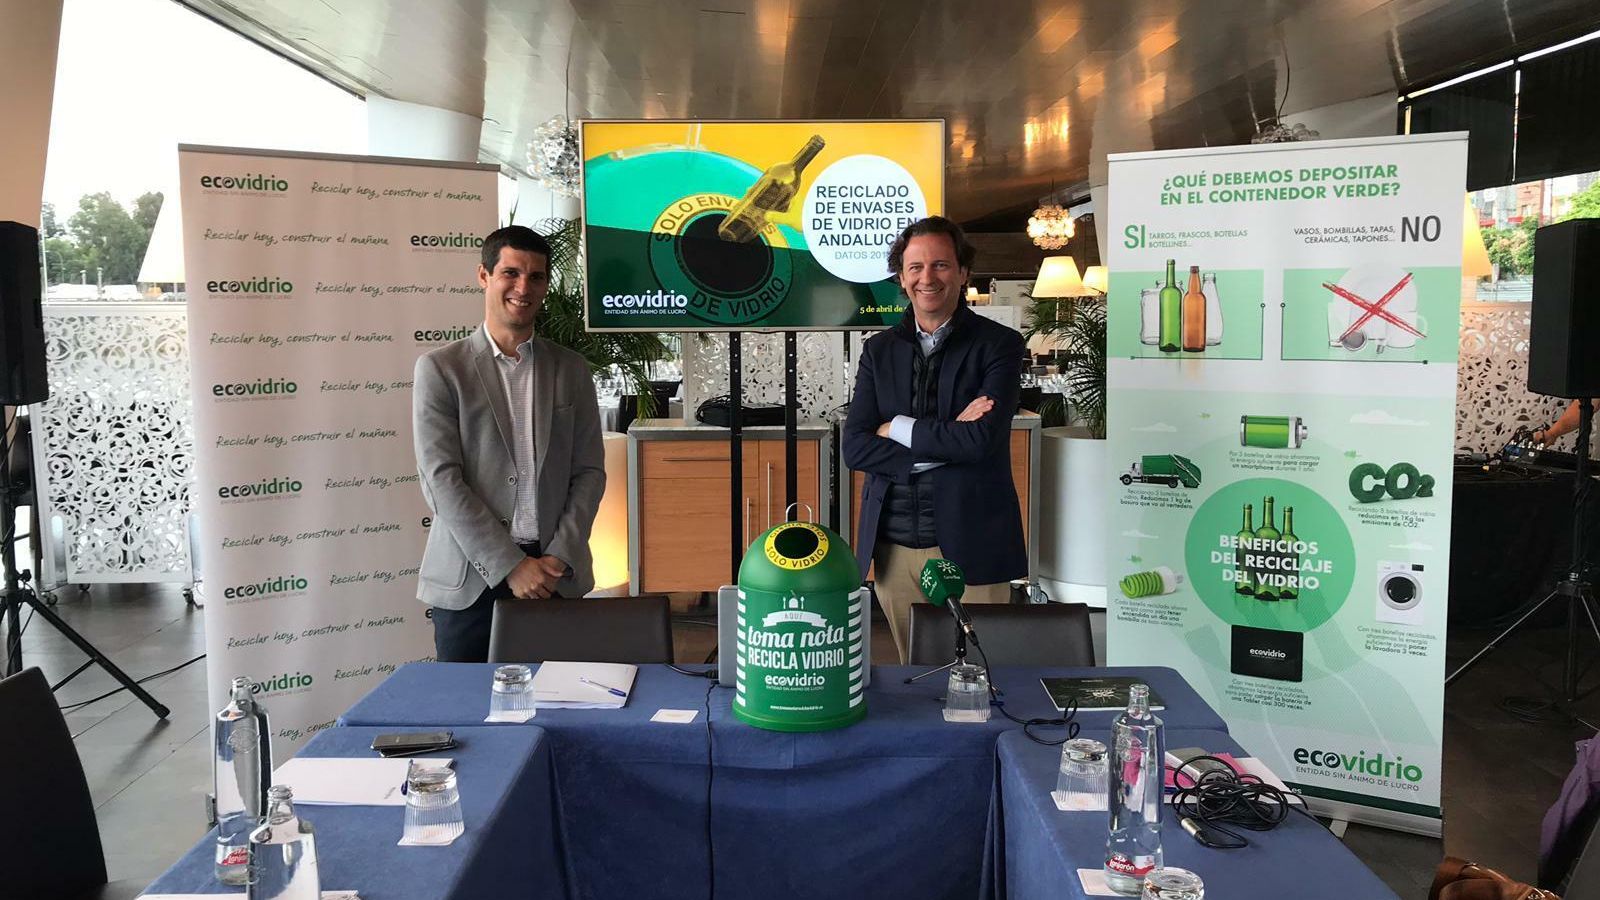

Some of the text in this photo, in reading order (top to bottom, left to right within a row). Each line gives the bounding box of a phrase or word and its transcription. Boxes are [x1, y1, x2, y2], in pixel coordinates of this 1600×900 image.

[200, 174, 288, 192] ecovidrio
[1163, 164, 1398, 191] ¿QUÉ DEBEMOS DEPOSITAR
[311, 182, 352, 194] Reciclar
[383, 187, 429, 199] construir
[434, 189, 442, 199] el
[446, 191, 482, 202] mañana
[816, 185, 909, 198] RECICLADO
[1160, 182, 1401, 206] EN EL CONTENEDOR VERDE?
[815, 201, 914, 214] DE ENVASES
[654, 202, 693, 242] SOLO
[812, 218, 832, 230] DE
[838, 218, 892, 230] VIDRIO
[1294, 226, 1396, 236] VASOS, BOMBILLAS, TAPAS,
[1400, 215, 1441, 242] NO
[204, 229, 248, 241] Reciclar
[281, 233, 332, 243] construir
[337, 233, 346, 243] el
[350, 235, 390, 245] mañana
[410, 233, 484, 248] ecovidrio
[1124, 223, 1146, 250] SI
[1214, 230, 1248, 238] BOTELLAS
[834, 251, 868, 260] DATOS
[206, 276, 293, 293] ecovidrio
[315, 281, 356, 294] Reciclar
[386, 284, 432, 294] construir
[436, 284, 445, 294] el
[450, 284, 486, 295] mañana
[602, 290, 688, 308] ecovidrio
[690, 277, 785, 318] DE VIDRIO
[860, 304, 865, 314] 5
[866, 304, 874, 313] de
[876, 304, 892, 313] abril
[894, 304, 903, 313] de
[210, 332, 252, 345] Reciclar
[286, 333, 336, 343] construir
[341, 331, 350, 342] el
[355, 332, 394, 343] mañana
[212, 378, 298, 396] ecovidrio
[320, 380, 360, 393] Reciclar
[216, 434, 260, 448] Reciclar
[291, 431, 341, 442] construir
[345, 428, 356, 440] el
[359, 428, 399, 440] mañana
[218, 477, 302, 498] ecovidrio
[325, 476, 364, 490] Reciclar
[1349, 462, 1435, 504] CO2
[222, 534, 264, 549] Reciclar
[296, 528, 346, 541] construir
[350, 524, 359, 534] el
[364, 522, 402, 534] mañana
[1220, 535, 1318, 554] BENEFICIOS
[766, 546, 824, 568] SOLO VIDRIO
[1211, 551, 1332, 574] DEL RECICLAJE
[224, 575, 308, 599] ecovidrio
[330, 572, 369, 586] Reciclar
[1222, 569, 1320, 590] DEL VIDRIO
[227, 634, 270, 650] Reciclar
[302, 623, 350, 638] construir
[354, 619, 364, 630] el
[367, 615, 406, 627] mañana
[748, 624, 845, 648] toma nota
[748, 648, 844, 670] RECICLA VIDRIO
[1250, 648, 1286, 658] ecovidrio
[334, 666, 373, 681] Reciclar
[764, 672, 826, 686] ecovidrio
[1293, 748, 1422, 782] ecovidrio
[1296, 766, 1331, 777] ENTIDAD
[1333, 772, 1346, 780] SIN
[1377, 779, 1388, 787] DE
[1390, 782, 1419, 792] LUCRO
